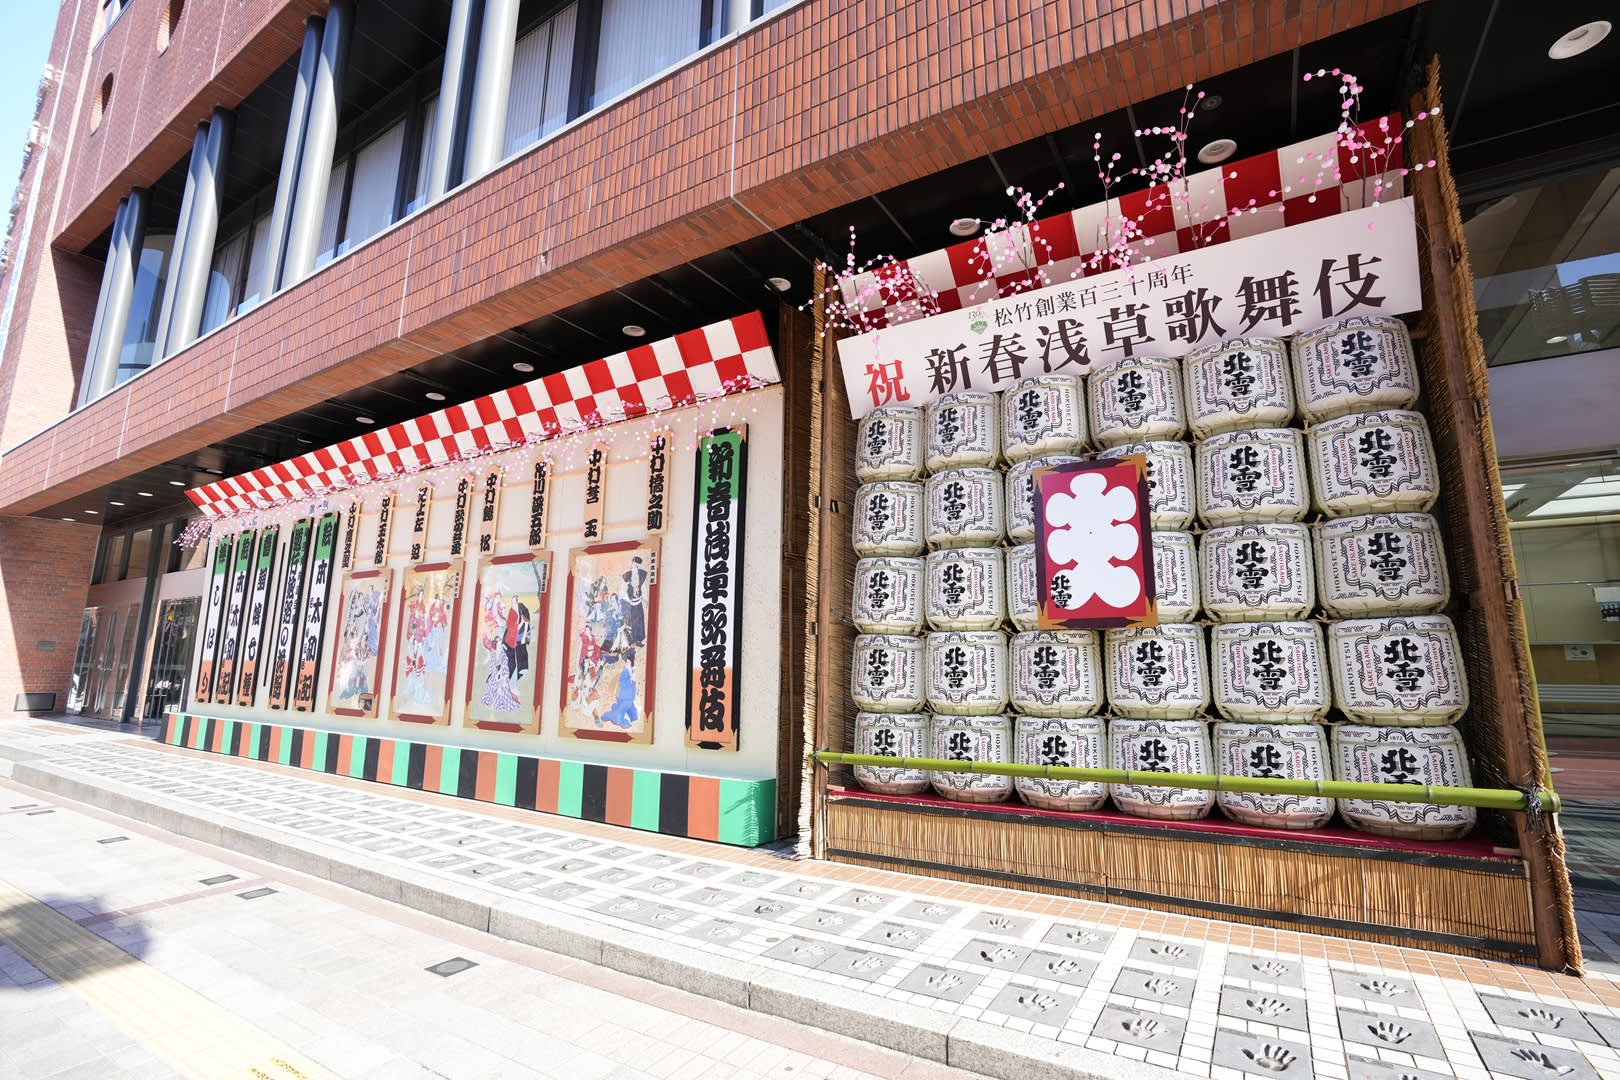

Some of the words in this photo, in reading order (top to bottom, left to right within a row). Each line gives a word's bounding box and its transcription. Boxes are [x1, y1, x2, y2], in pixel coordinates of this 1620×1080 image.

[994, 263, 1194, 327] 松竹創業百三十周年
[865, 359, 911, 407] 祝
[926, 252, 1385, 395] 新春浅草歌舞伎
[1223, 352, 1256, 397] 北雪
[1341, 331, 1378, 378] 北雪
[1019, 390, 1043, 430] 北雪
[1118, 370, 1147, 413] 北雪
[867, 420, 886, 456] 北雪
[938, 408, 959, 444] 北雪
[1230, 446, 1262, 492] 北雪
[1286, 447, 1295, 498] HOKUSETSU
[1322, 441, 1333, 494] HOKUSETSU
[1359, 429, 1397, 479] 北雪
[647, 435, 666, 531] 中村橋之助
[943, 482, 966, 521] 北雪
[869, 494, 889, 530] 北雪
[1180, 549, 1188, 600] HOKUSETSU
[1235, 541, 1269, 589] 北雪
[1294, 543, 1302, 596] HOKUSETSU
[1330, 539, 1340, 592] HOKUSETSU
[1368, 533, 1407, 581] 北雪
[699, 441, 735, 732] 新春浅草歌舞伎
[868, 571, 889, 608] 北雪
[943, 563, 965, 604] 北雪
[1050, 575, 1072, 608] 北雪
[868, 649, 889, 686] 北雪
[944, 646, 968, 688] 北雪
[1033, 646, 1060, 689] 北雪
[1136, 640, 1167, 687] 北雪
[1189, 641, 1198, 693] HOKUSETSU
[1251, 640, 1287, 691] 北雪
[1310, 641, 1319, 698] HOKUSETSU
[1344, 642, 1357, 699] HOKUSETSU
[1363, 645, 1372, 669] ISLAND
[1384, 637, 1425, 692] 北雪
